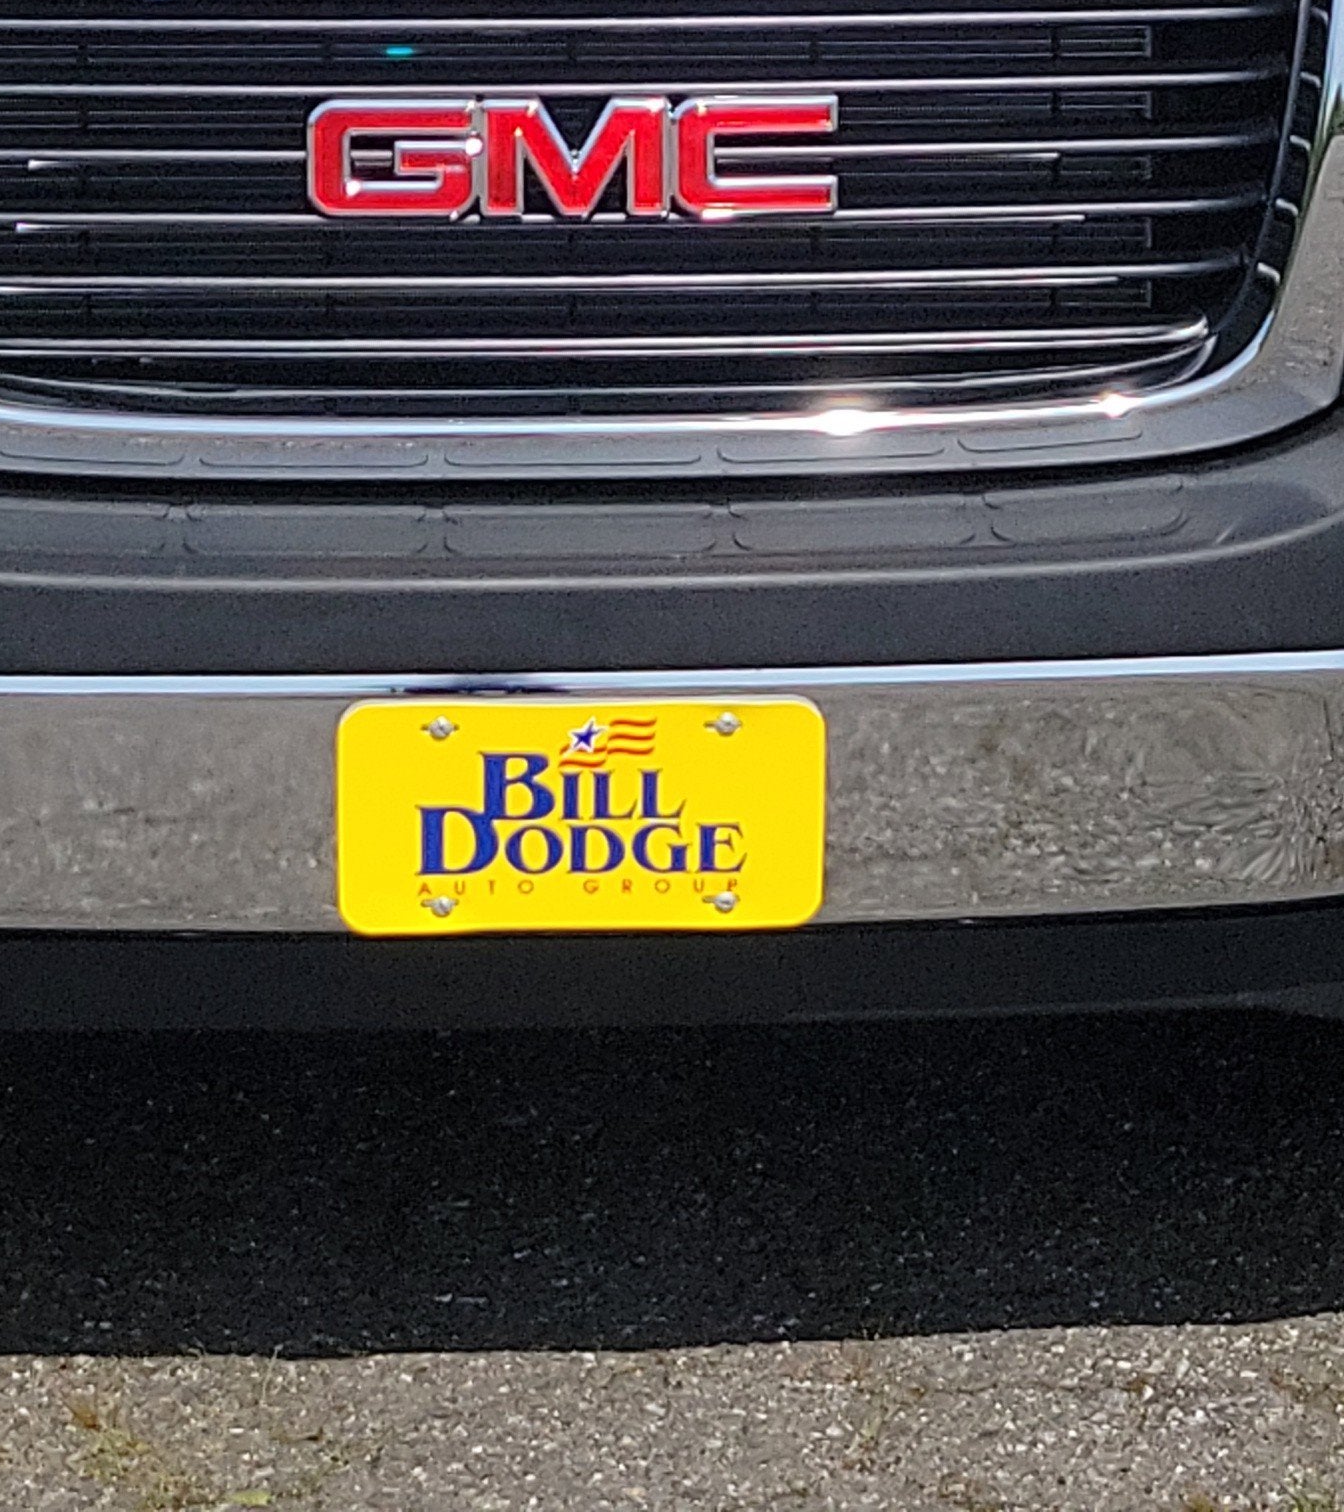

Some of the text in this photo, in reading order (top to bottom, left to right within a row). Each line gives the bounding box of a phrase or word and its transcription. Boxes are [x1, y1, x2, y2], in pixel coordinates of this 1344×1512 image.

[307, 95, 839, 218] GMC
[479, 751, 687, 821] BILL
[414, 804, 748, 877] DODGE
[416, 878, 739, 896] AUTO GROUP
